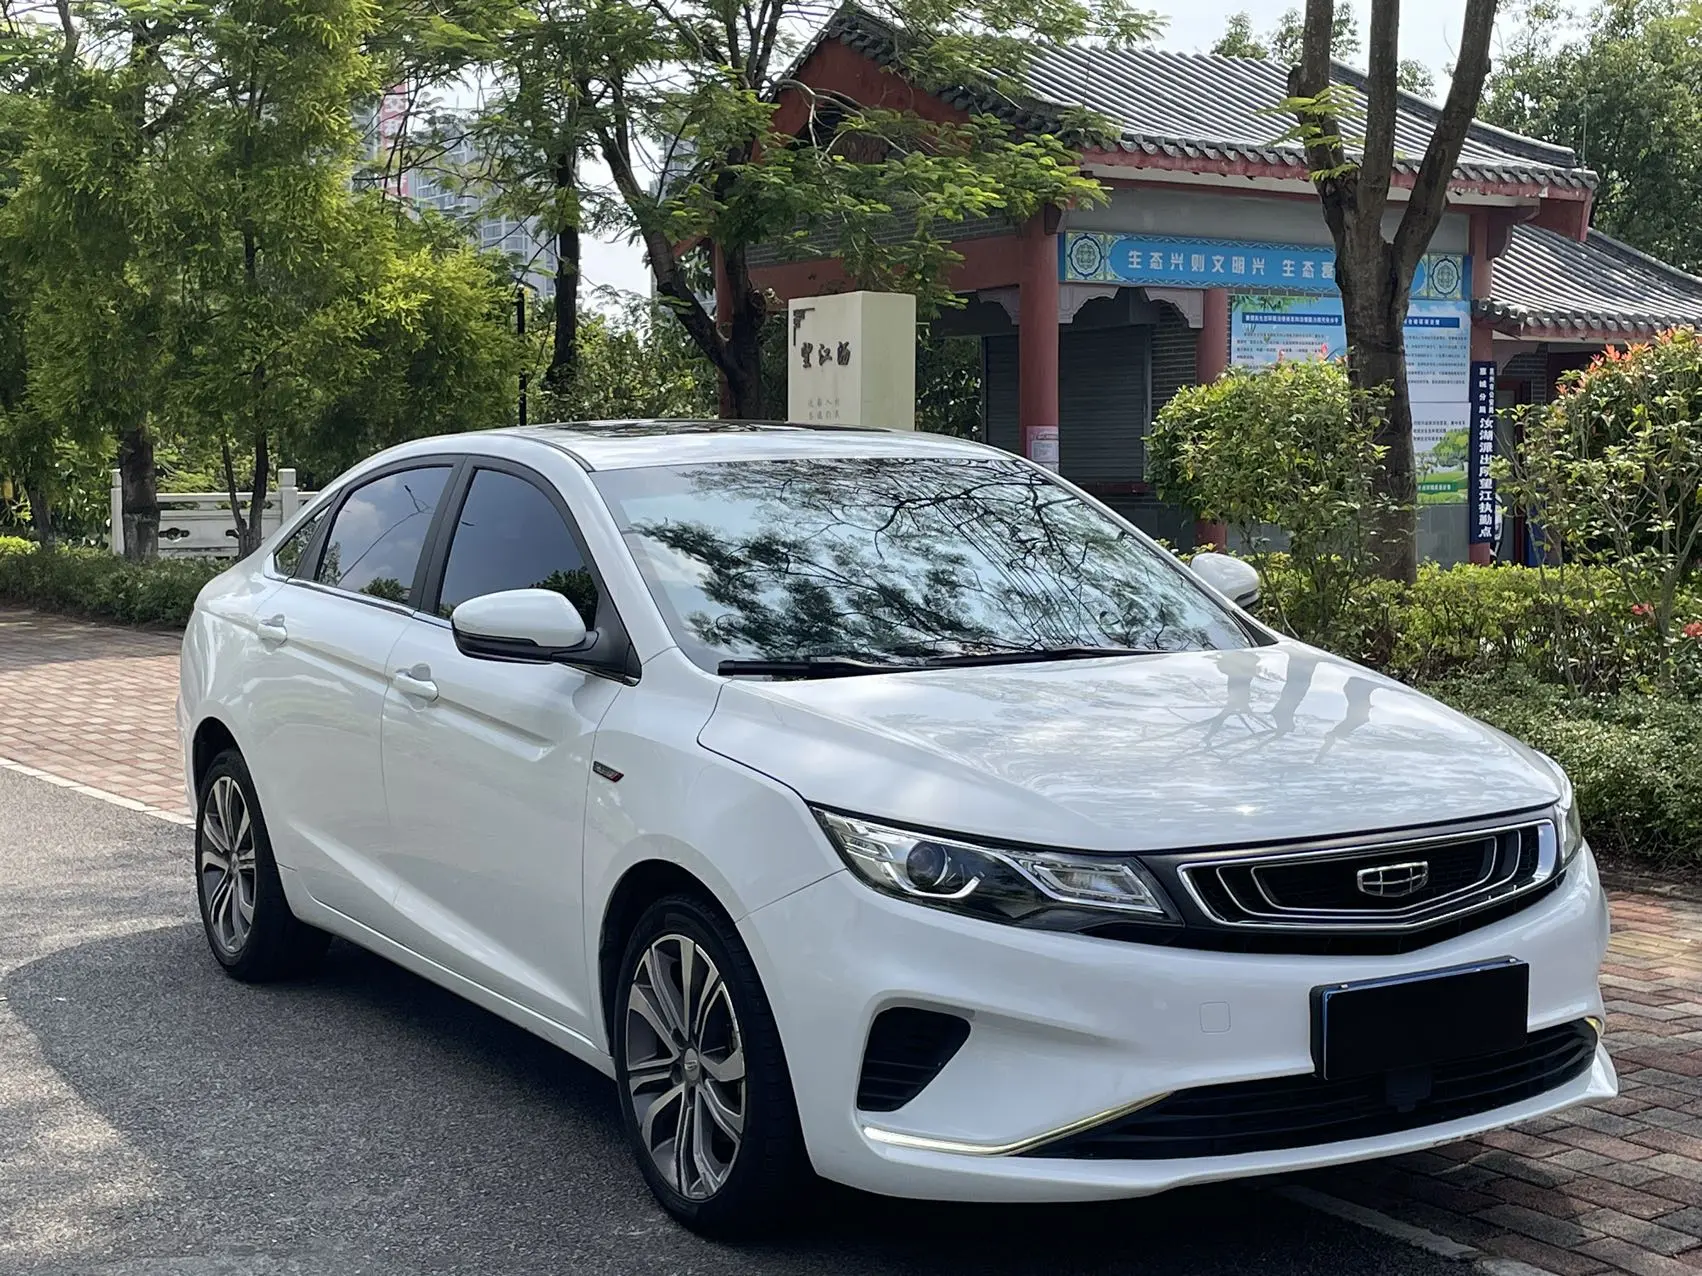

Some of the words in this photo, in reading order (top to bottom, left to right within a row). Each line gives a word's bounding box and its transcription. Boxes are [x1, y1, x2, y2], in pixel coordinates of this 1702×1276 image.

[1128, 250, 1265, 276] 生态兴则文明兴
